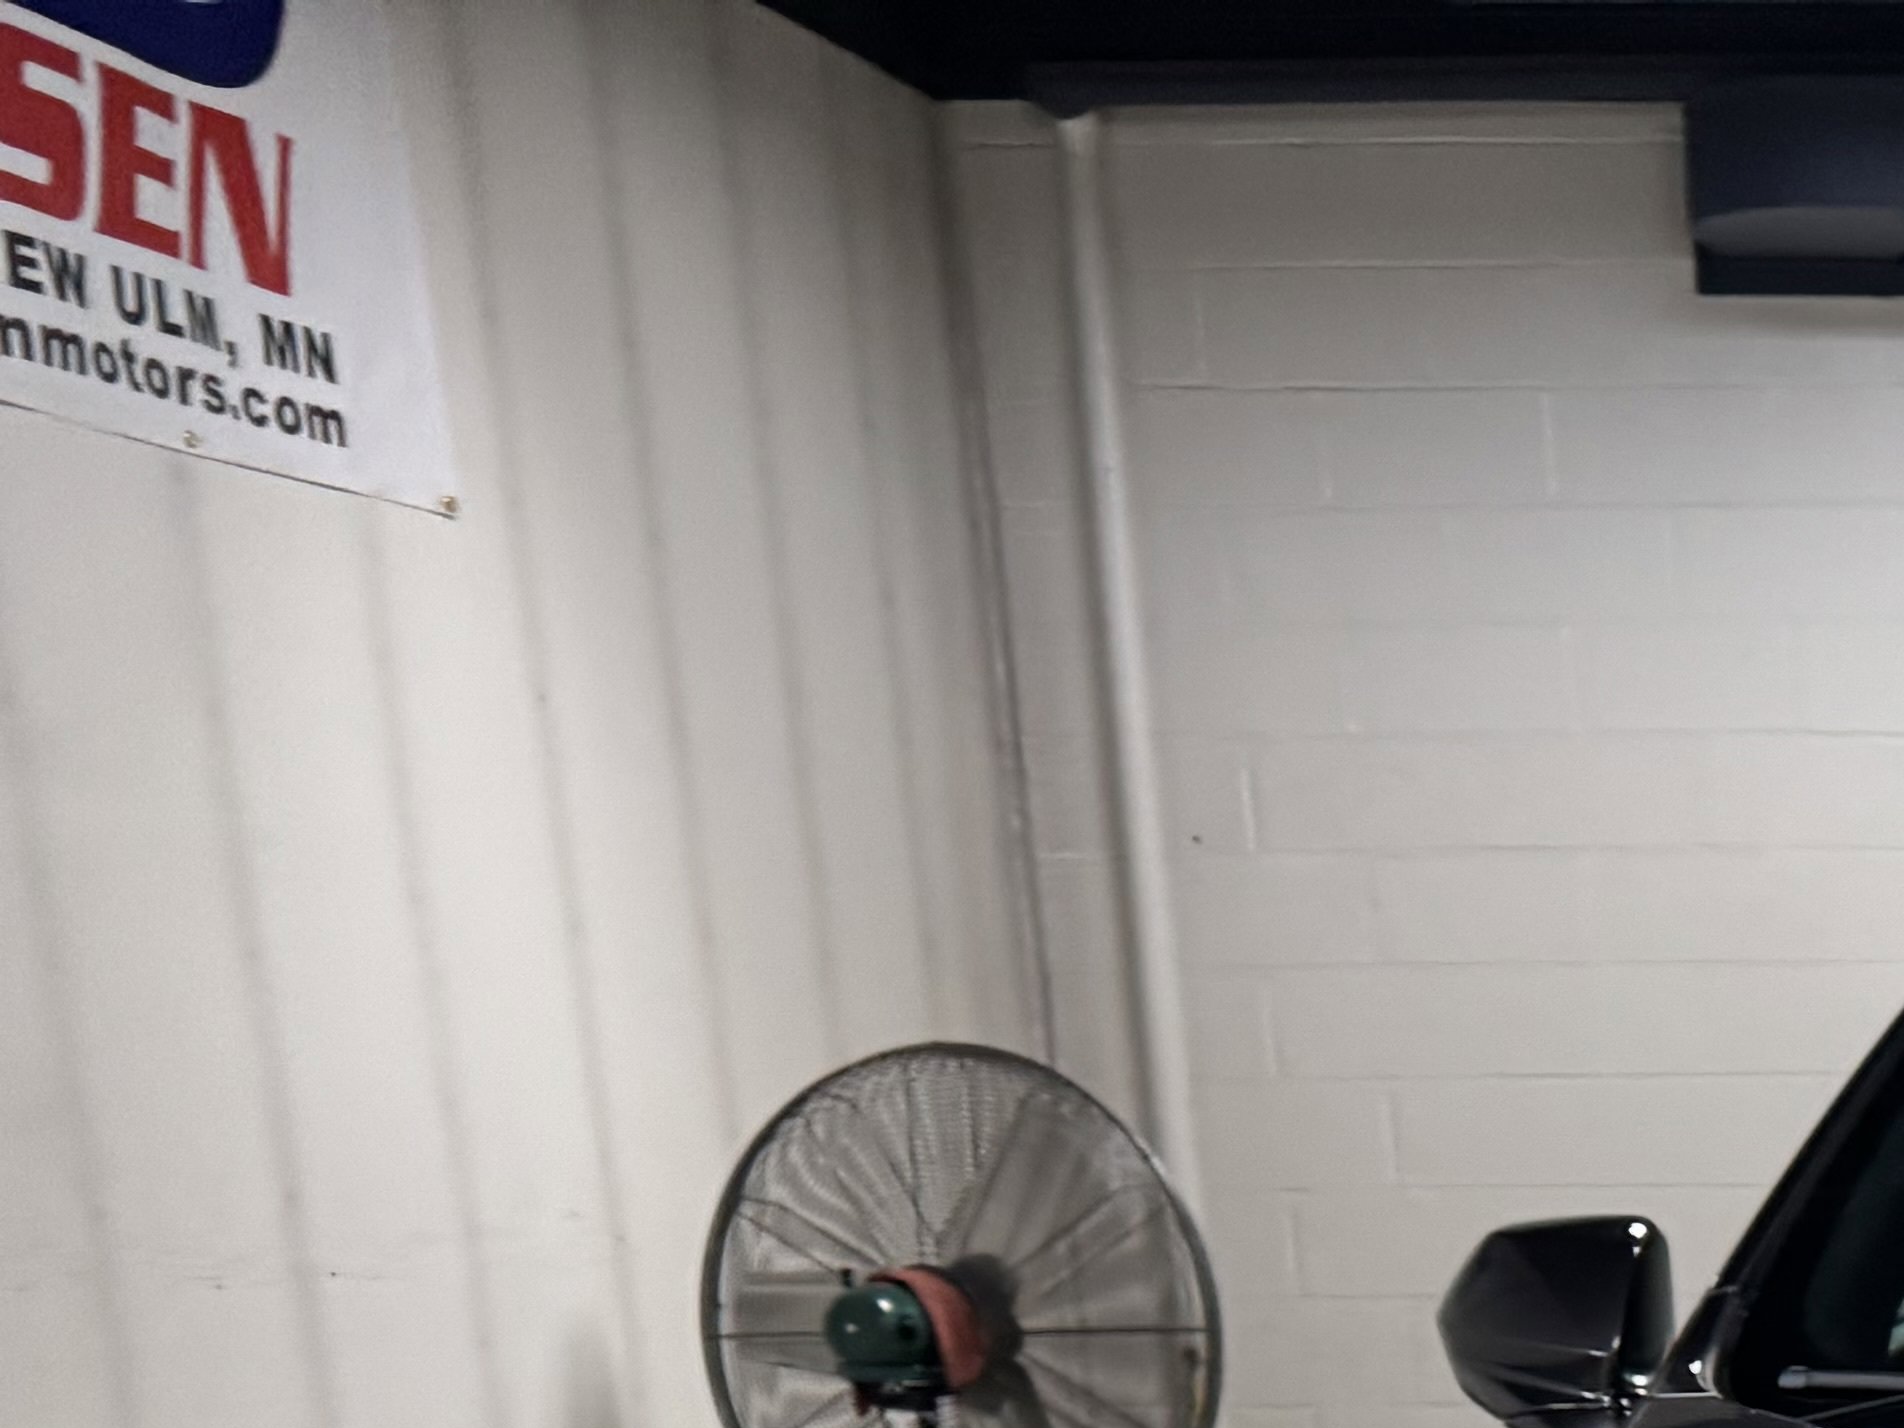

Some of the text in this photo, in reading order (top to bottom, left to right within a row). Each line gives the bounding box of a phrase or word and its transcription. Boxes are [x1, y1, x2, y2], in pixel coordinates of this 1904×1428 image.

[0, 22, 293, 297] SEN
[0, 313, 350, 448] nmotors.com
[109, 264, 239, 368] ULM,
[257, 313, 338, 384] MN
